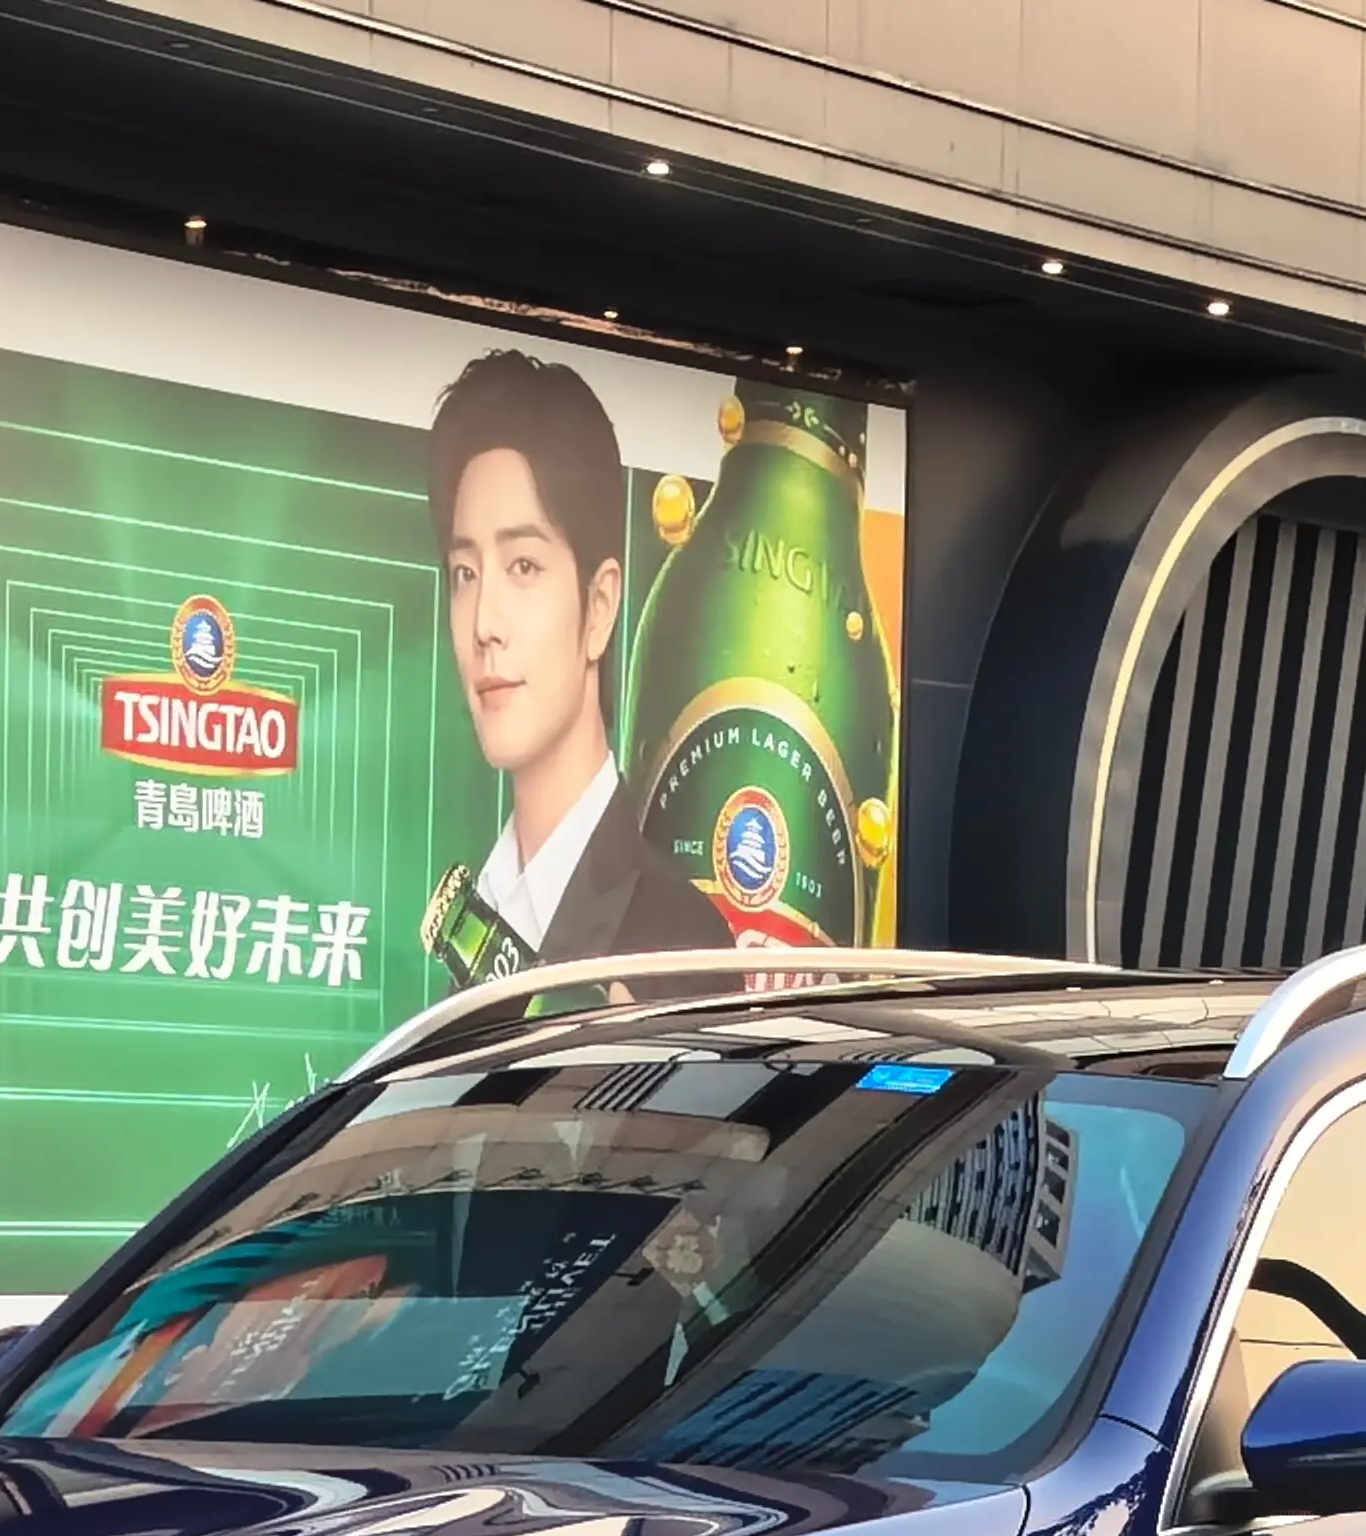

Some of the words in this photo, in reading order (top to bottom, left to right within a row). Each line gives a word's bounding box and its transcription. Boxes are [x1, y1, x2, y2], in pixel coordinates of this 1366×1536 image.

[114, 691, 287, 759] TSINGTAO
[134, 779, 265, 840] 青島啤酒
[659, 727, 740, 810] PREMIUM
[751, 729, 813, 783] LAGER
[816, 788, 847, 866] BEER
[673, 839, 705, 857] SINCE
[485, 936, 520, 982] 03
